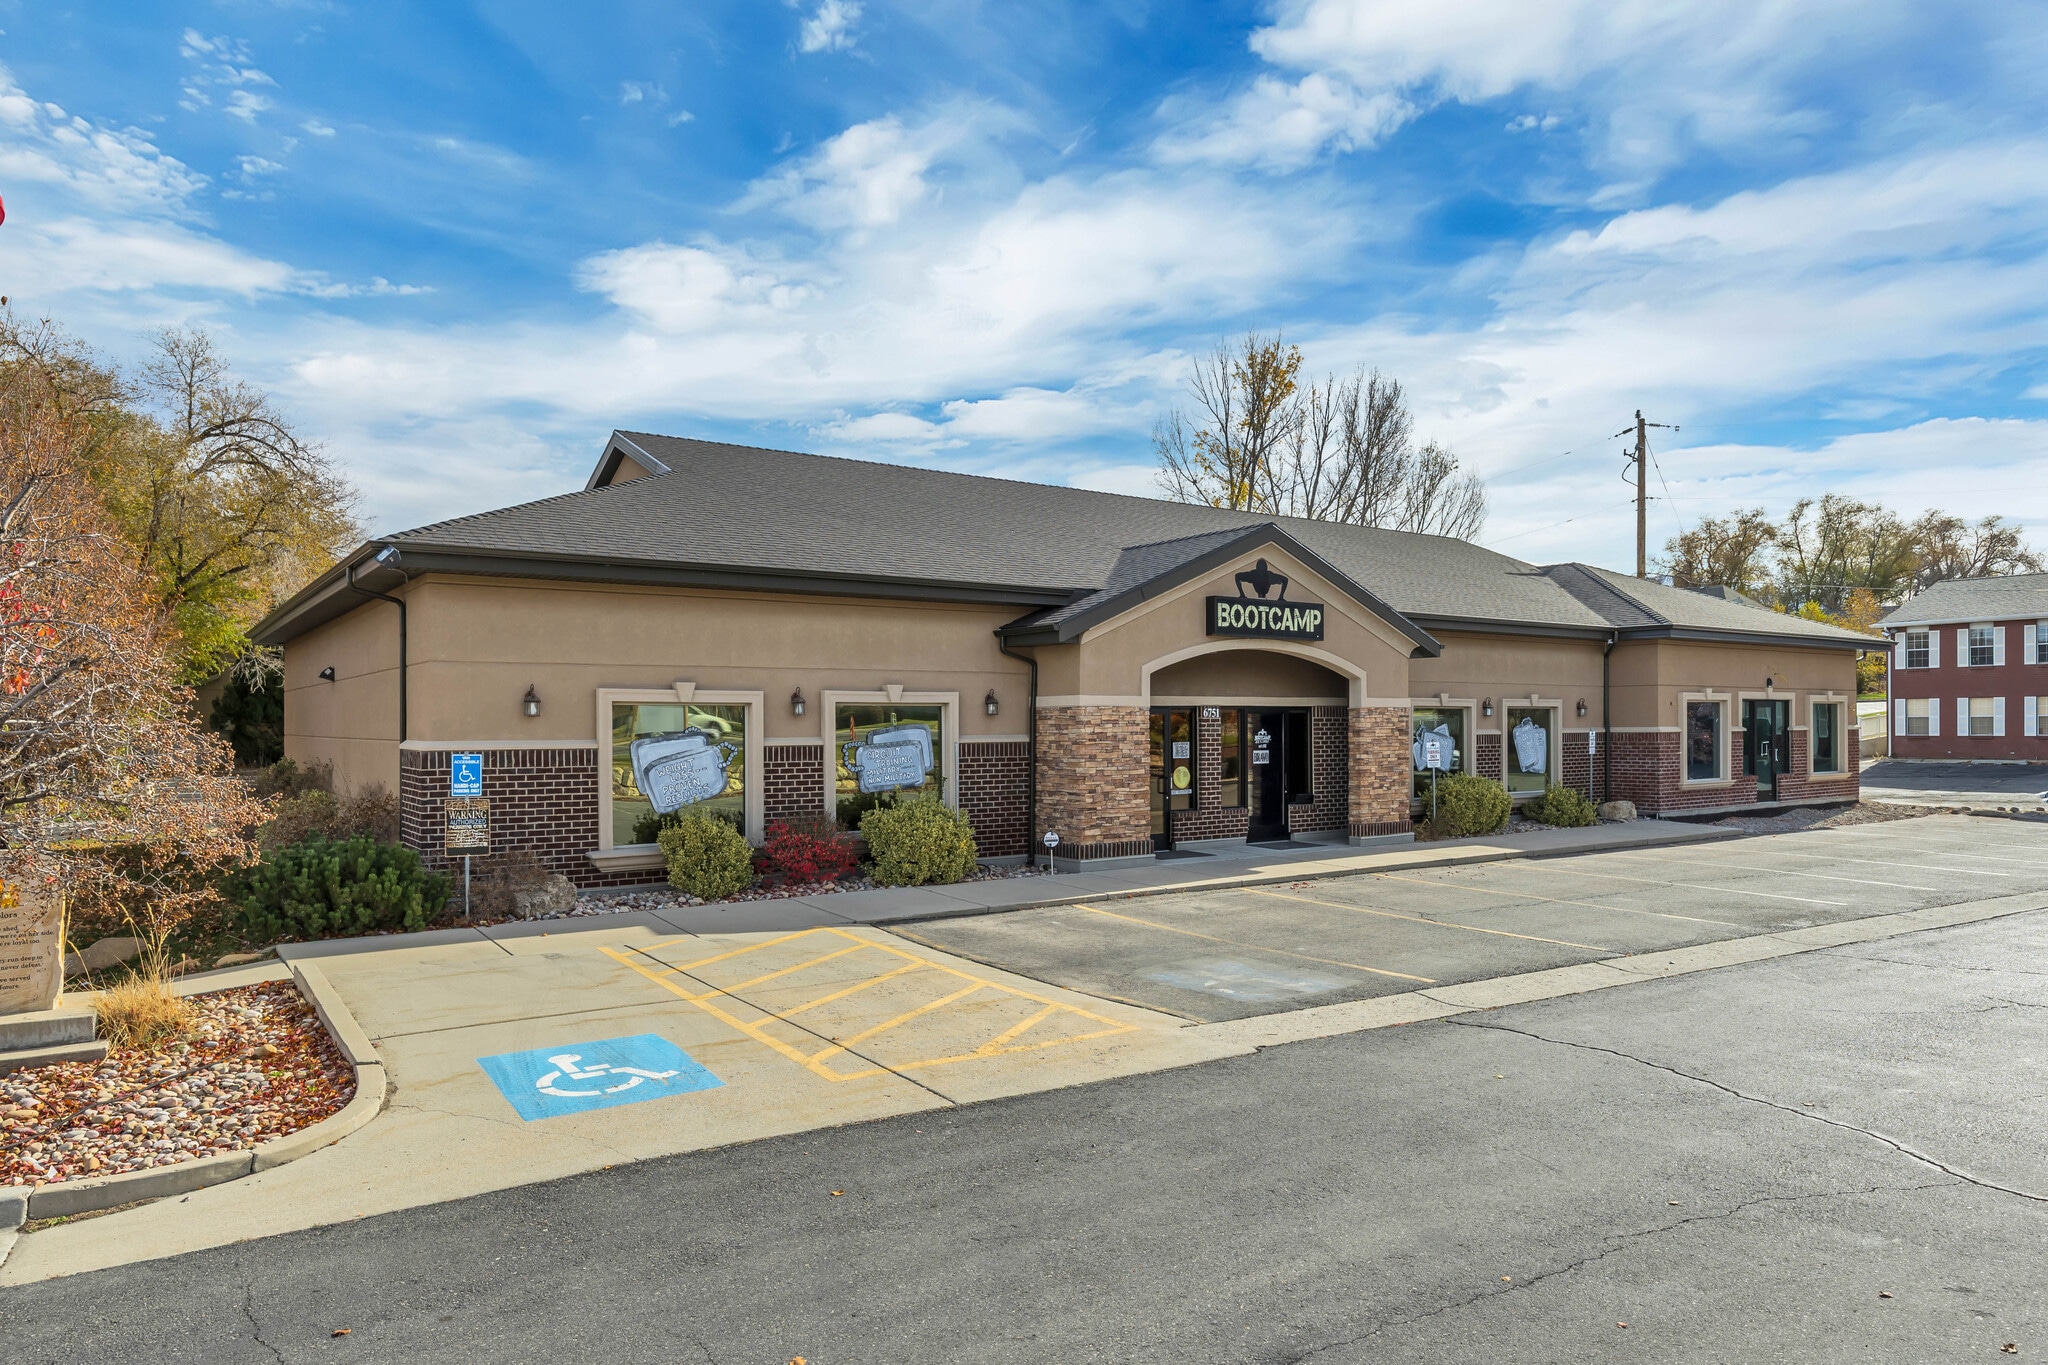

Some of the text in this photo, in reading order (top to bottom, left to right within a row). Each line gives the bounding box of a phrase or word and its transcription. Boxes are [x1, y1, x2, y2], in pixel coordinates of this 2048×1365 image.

[1217, 602, 1322, 633] BOOTCAMP
[1203, 708, 1220, 718] 6751
[867, 747, 902, 760] CIRCUIT
[655, 758, 695, 778] WEIGHT
[875, 755, 913, 768] TRAINING
[866, 766, 900, 777] MILITARY
[661, 777, 701, 795] PROVEN
[665, 783, 711, 805] RESULTS
[448, 810, 487, 820] WARNING
[20, 955, 36, 963] deep
